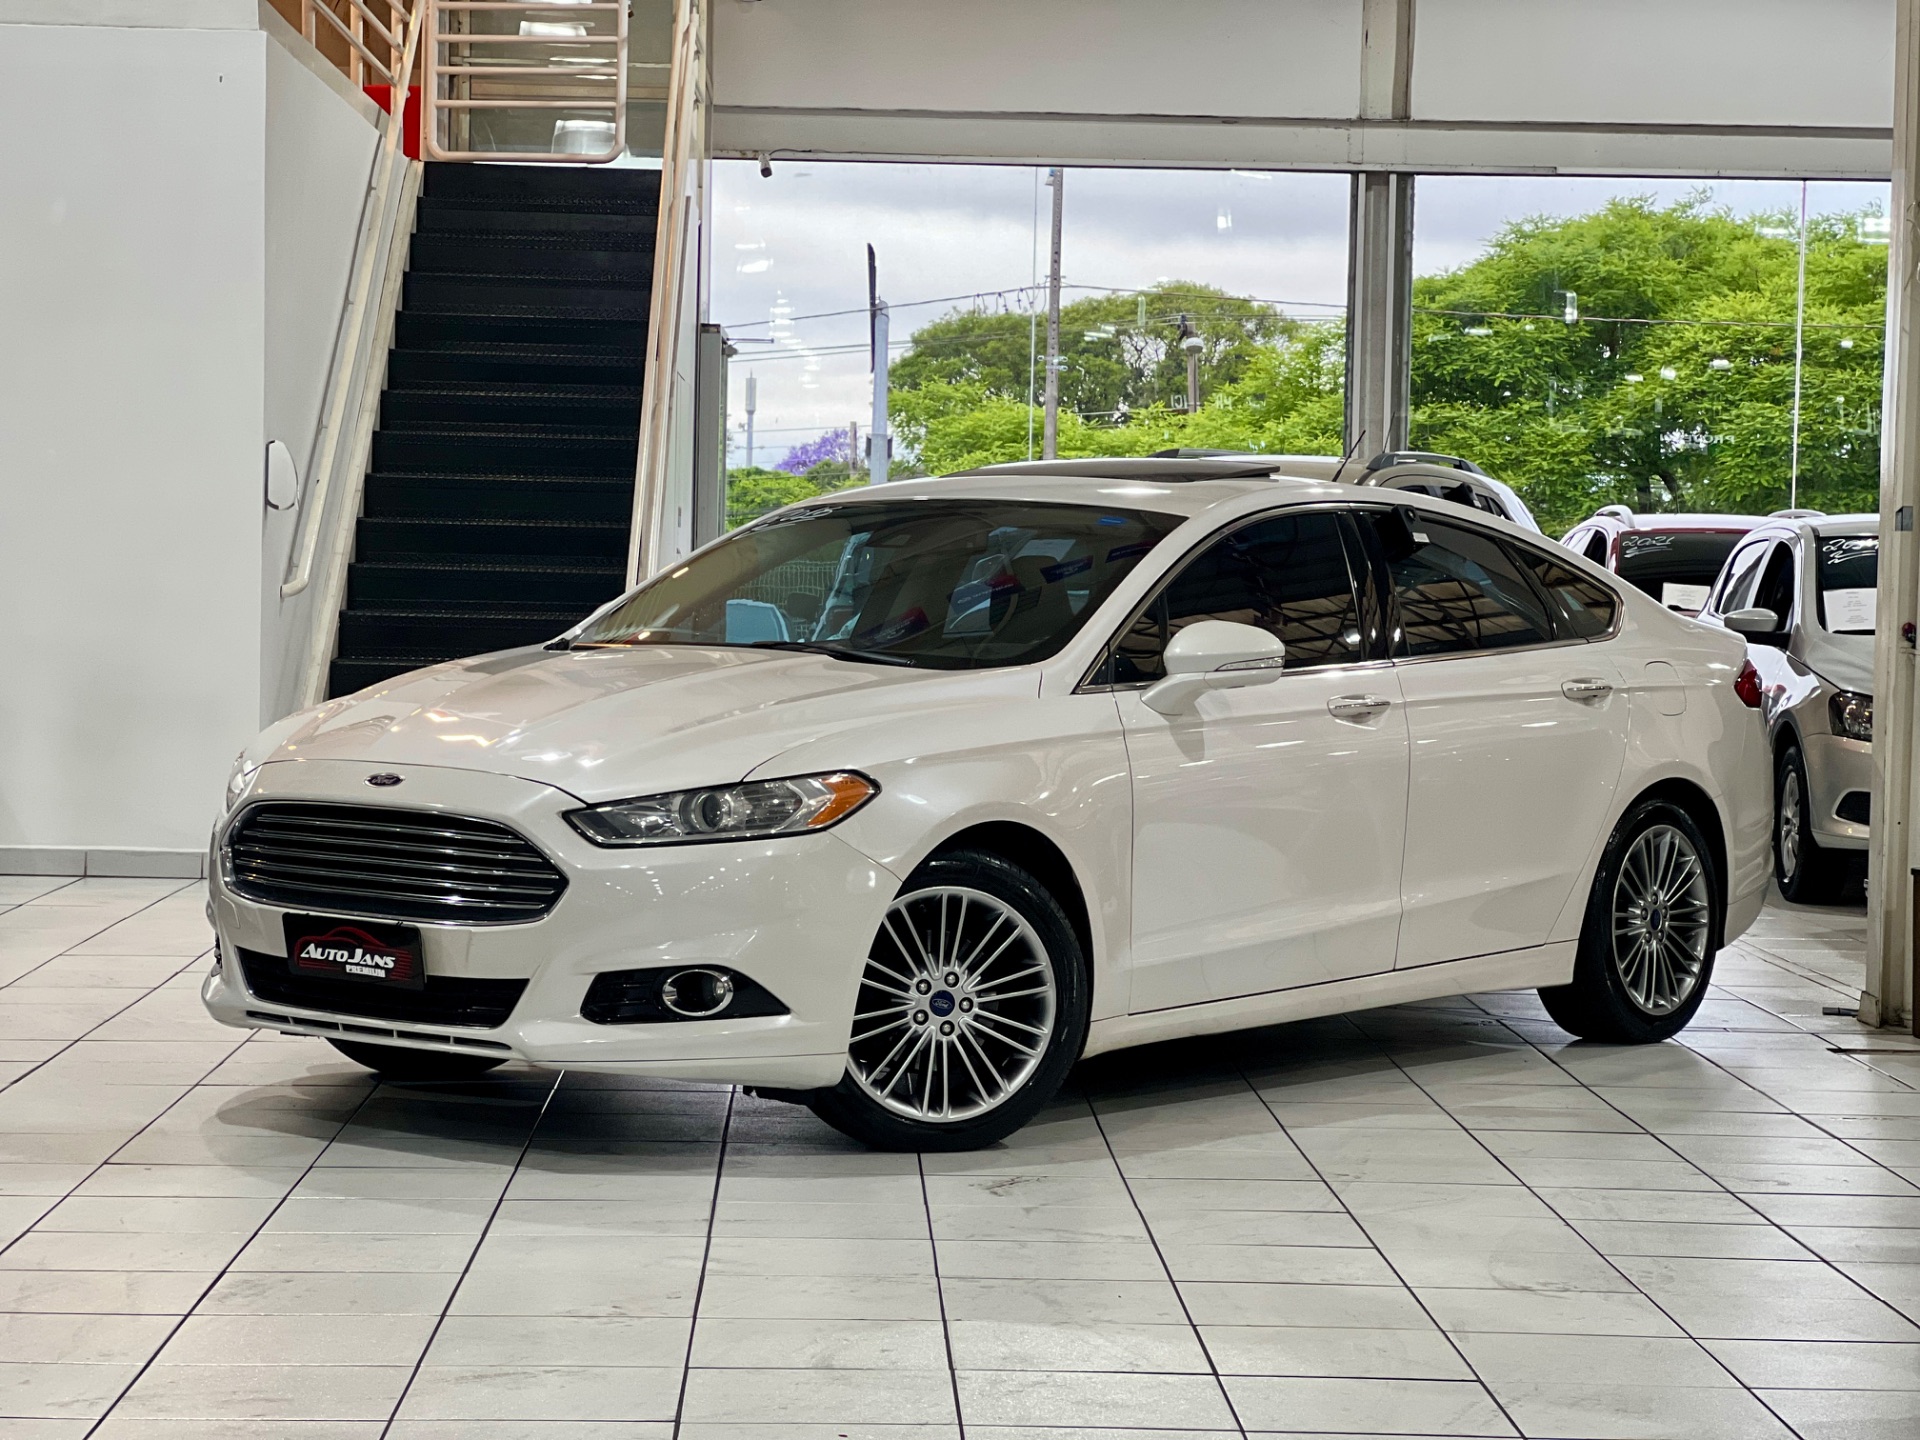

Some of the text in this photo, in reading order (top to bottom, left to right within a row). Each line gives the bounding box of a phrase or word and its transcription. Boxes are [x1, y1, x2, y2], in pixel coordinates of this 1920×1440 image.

[300, 943, 396, 969] AUTO JANS
[345, 964, 386, 978] PREMIUM
